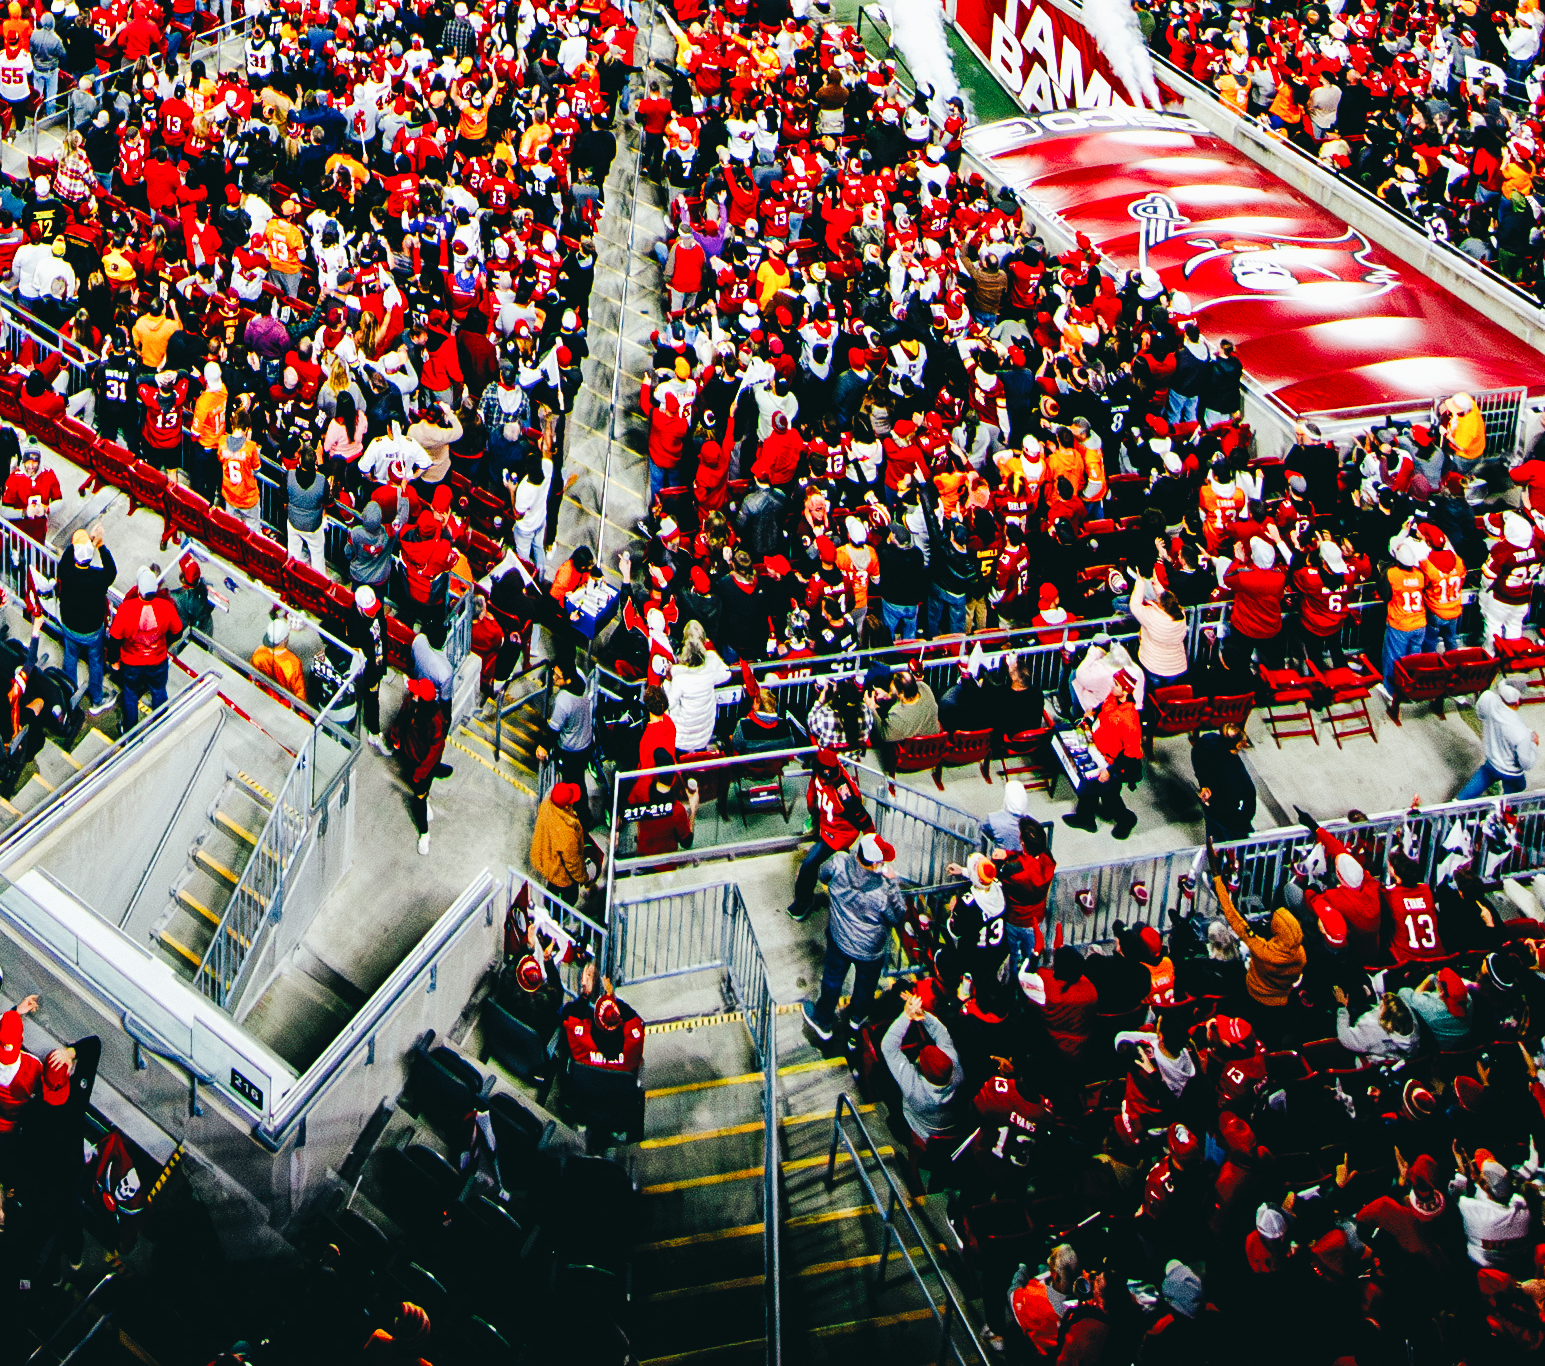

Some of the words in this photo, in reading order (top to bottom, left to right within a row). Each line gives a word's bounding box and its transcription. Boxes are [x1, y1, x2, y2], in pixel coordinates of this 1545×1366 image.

[0, 69, 24, 85] 55
[167, 115, 181, 131] 13
[683, 162, 691, 176] 7
[107, 381, 126, 400] 31
[156, 413, 177, 427] 13
[1111, 414, 1123, 432] 8
[827, 455, 843, 472] 12
[228, 461, 242, 485] 6
[980, 559, 994, 576] 5
[1329, 595, 1341, 612] 6
[1403, 591, 1422, 613] 13
[977, 919, 1003, 946] 13
[1405, 915, 1435, 948] 13
[1227, 1068, 1244, 1084] 13
[234, 1074, 260, 1102] 216
[1009, 1112, 1036, 1132] EVANS
[992, 1127, 1030, 1164] 13
